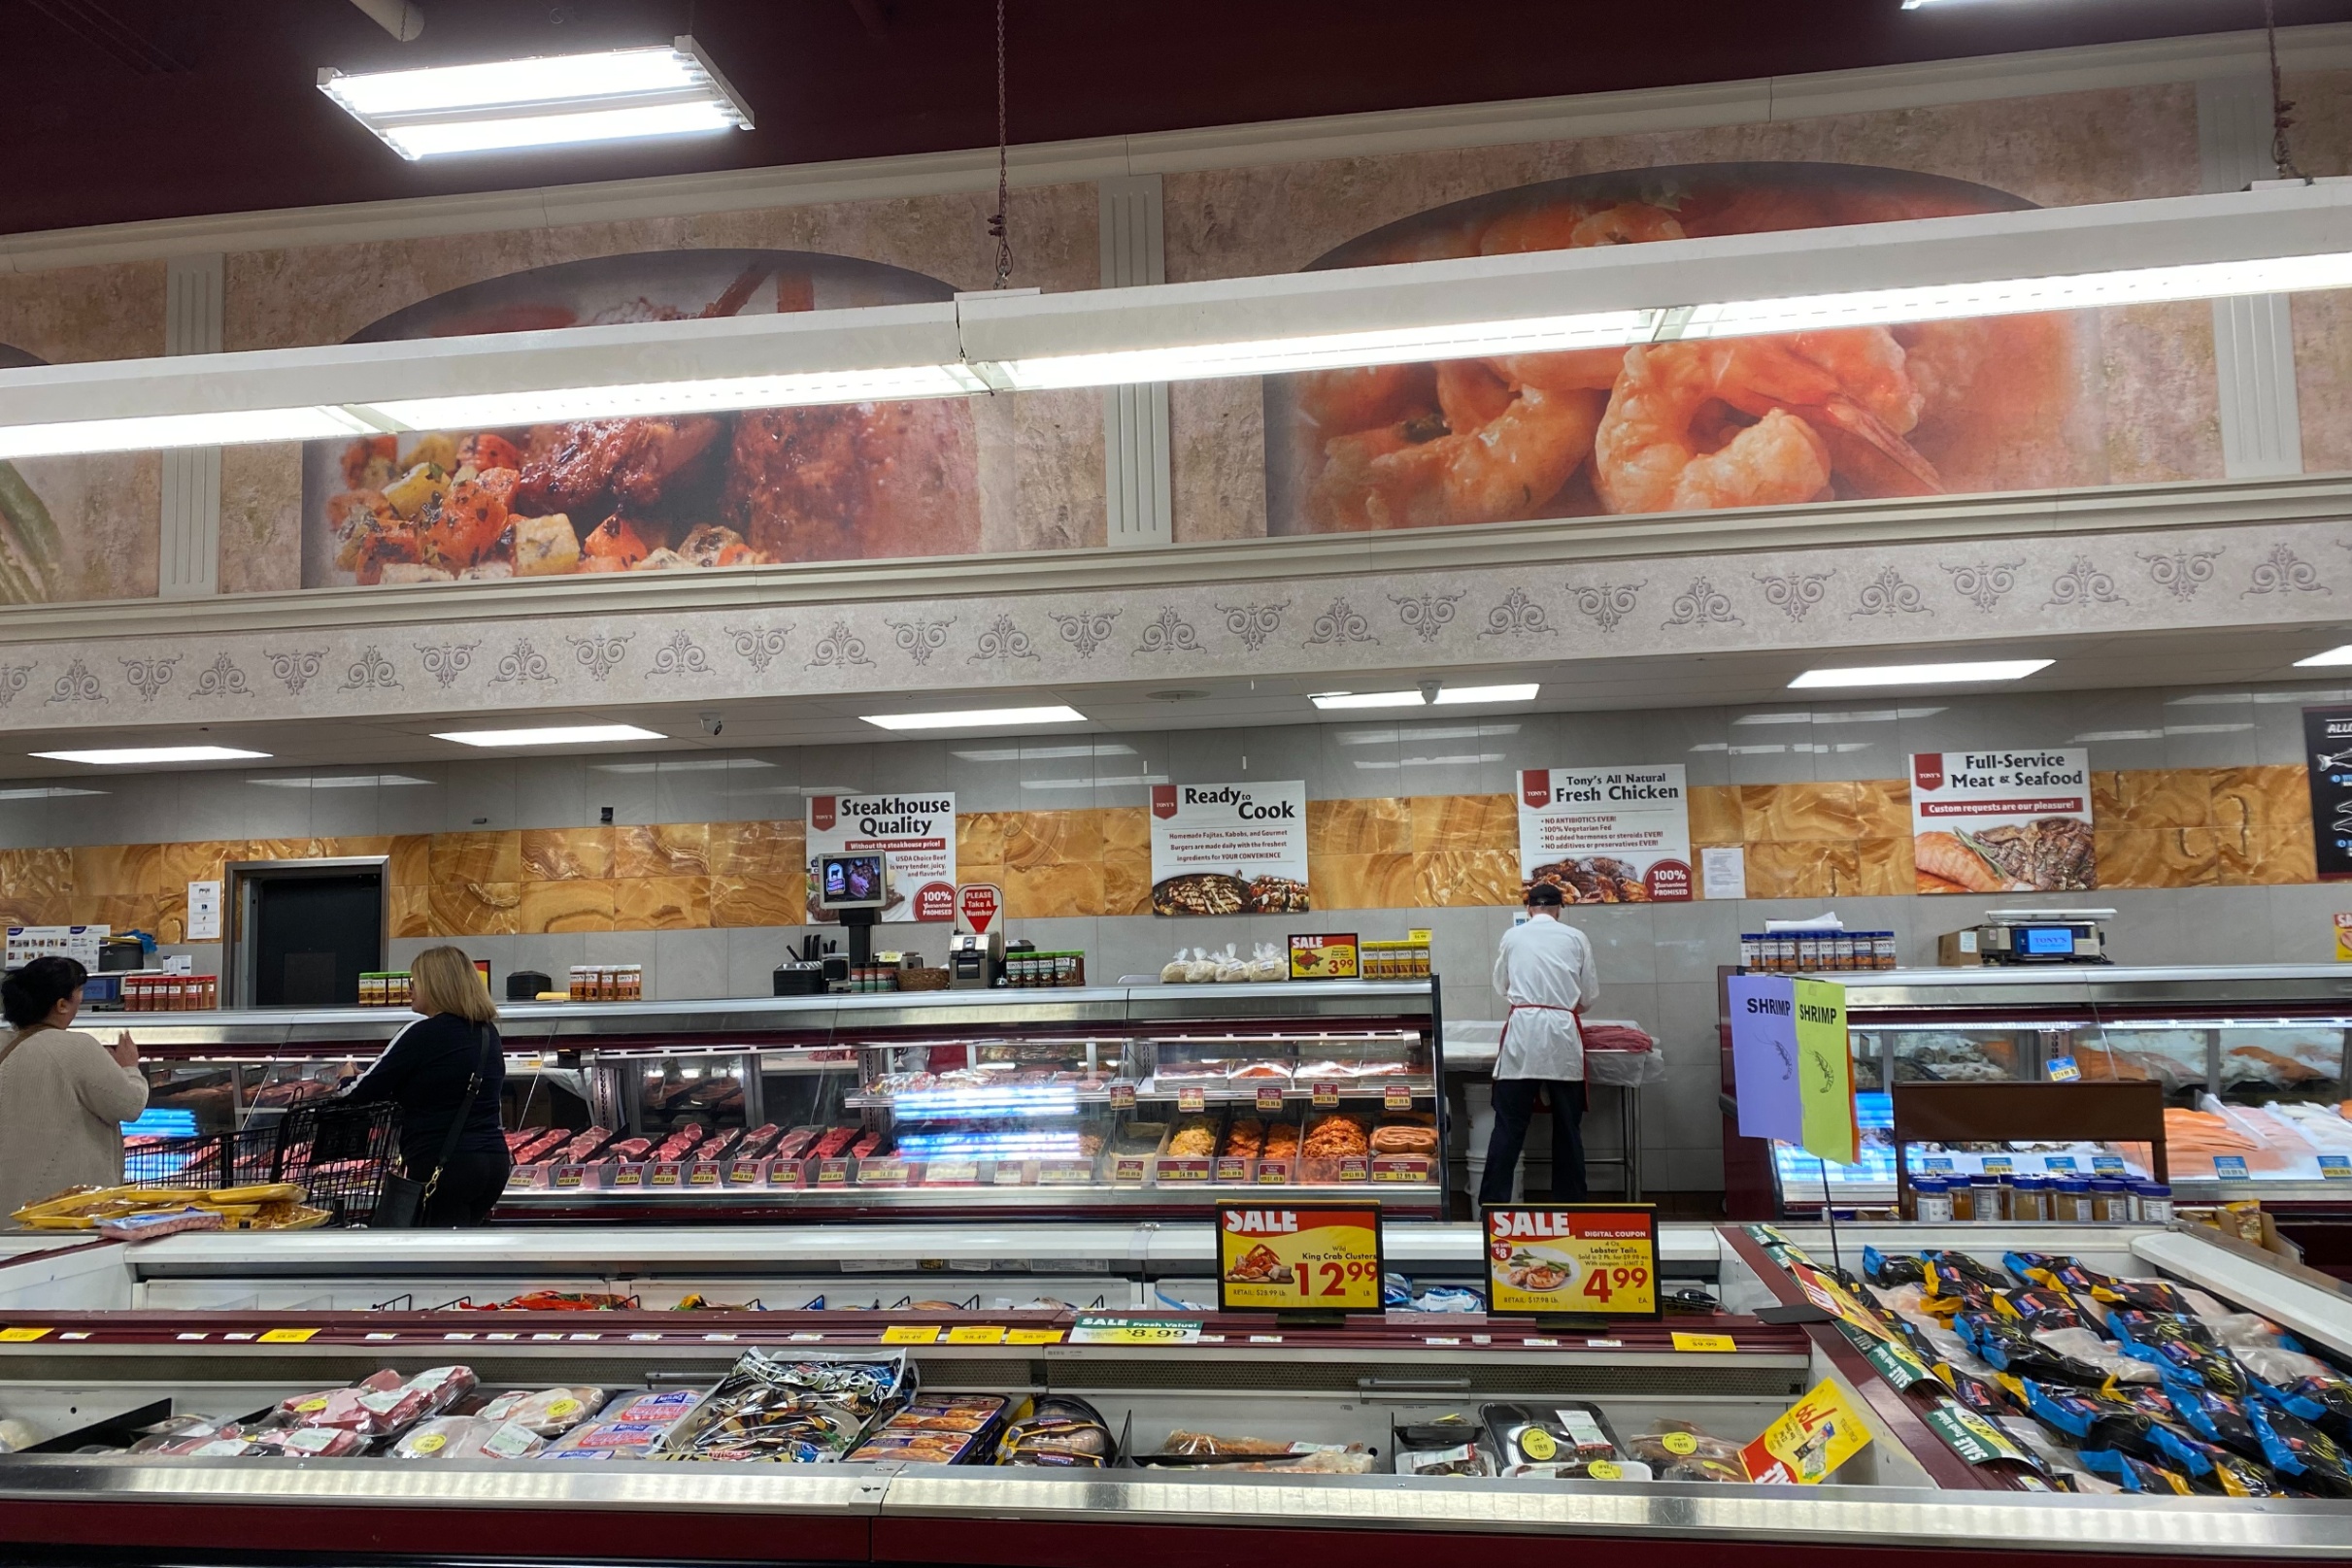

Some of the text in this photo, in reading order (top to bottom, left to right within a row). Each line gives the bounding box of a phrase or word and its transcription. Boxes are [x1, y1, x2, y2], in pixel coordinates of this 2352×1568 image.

[1966, 753, 2065, 769] Full-Service
[1566, 773, 1666, 786] Tony's All Natural
[1951, 774, 1994, 788] Meat
[2016, 771, 2083, 785] Seafood
[1185, 786, 1242, 805] Ready
[1556, 785, 1679, 802] Fresh Chicken
[841, 798, 950, 816] Steakhouse
[1238, 801, 1295, 819] Cook
[1929, 804, 1962, 813] Custom
[1963, 803, 2000, 814] requests
[2034, 801, 2074, 812] pleasure!
[859, 816, 932, 837] Quality
[923, 840, 940, 849] price!
[1654, 870, 1686, 881] 100%
[924, 891, 951, 901] 100%
[1292, 936, 1323, 949] SALE
[1747, 998, 1791, 1017] SHRIMP
[1800, 1004, 1837, 1025] SHRIMP
[1226, 1211, 1297, 1232] SALE
[1494, 1212, 1569, 1236] SALE
[1303, 1253, 1321, 1261] King
[1495, 1248, 1507, 1259] $8
[1082, 1318, 1128, 1326] SALE
[1126, 1328, 1188, 1338] $8.99
[1882, 1355, 1898, 1369] Fresh
[1888, 1365, 1914, 1389] SALE
[1933, 1410, 1988, 1461] SALE Fresh Value!
